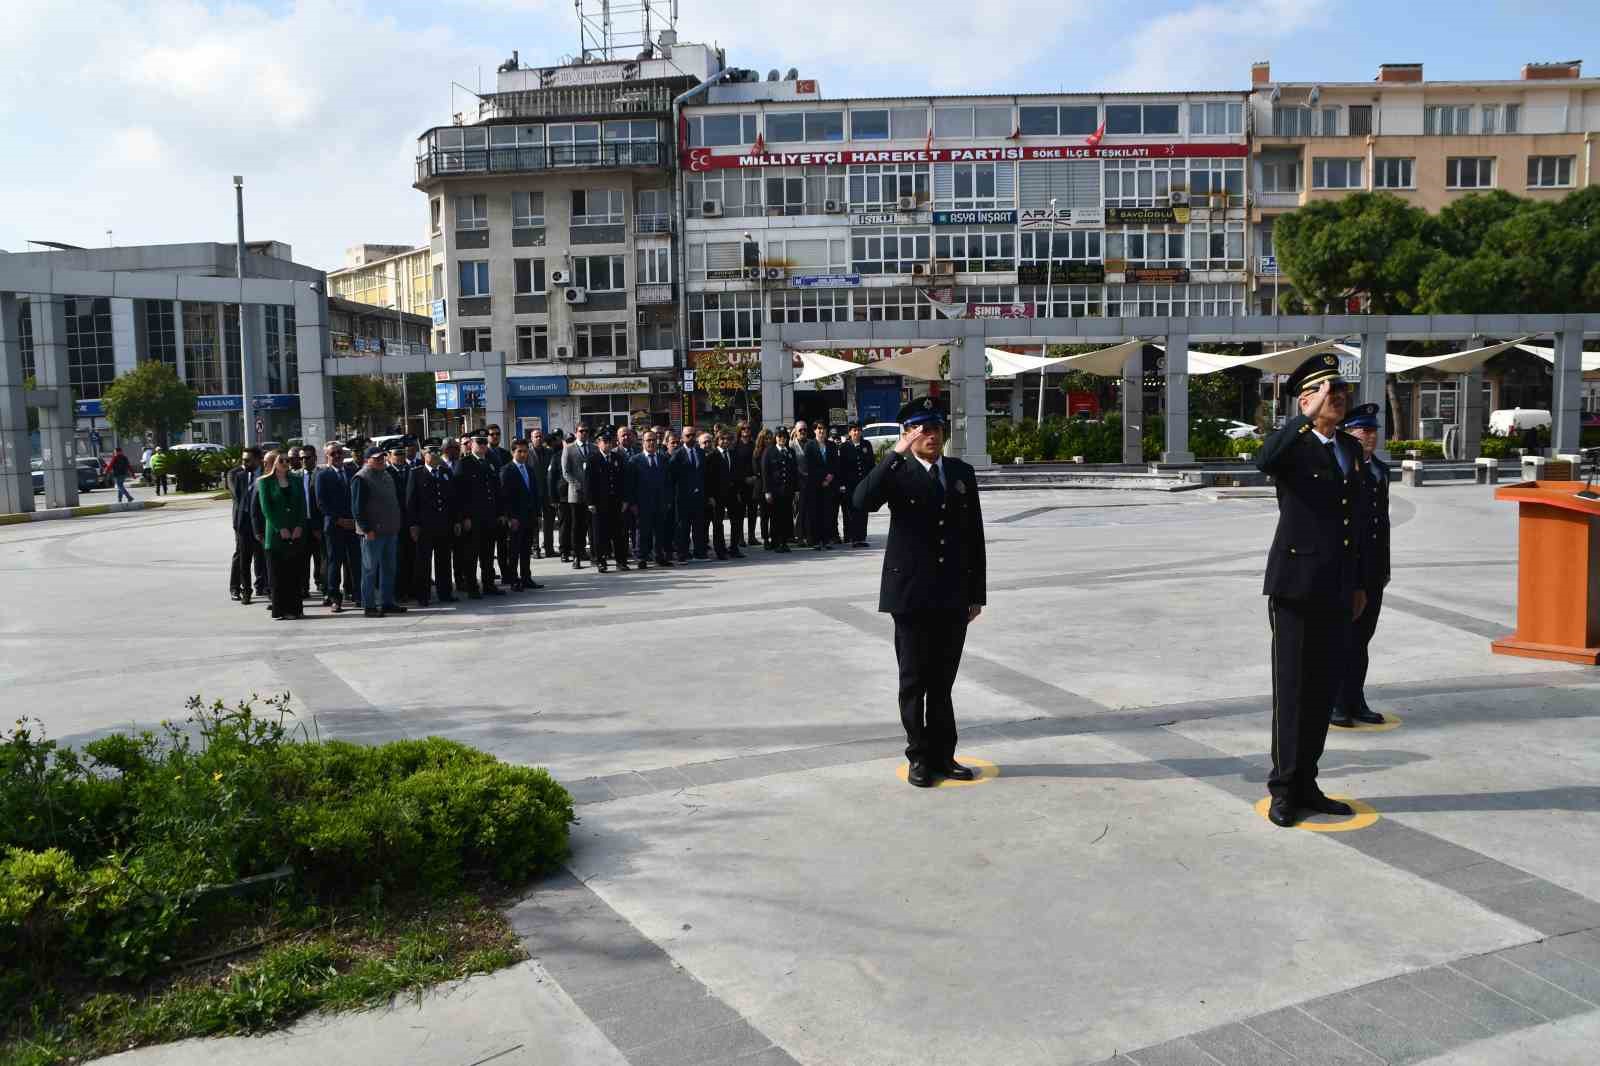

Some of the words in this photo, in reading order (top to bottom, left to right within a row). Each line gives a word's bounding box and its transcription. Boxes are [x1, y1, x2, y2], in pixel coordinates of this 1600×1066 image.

[851, 150, 941, 162] HAREKET
[951, 147, 1024, 160] PARTİSİ
[950, 212, 976, 223] ASYA
[977, 210, 1013, 224] İNŞAAT
[1022, 209, 1072, 218] ARAS
